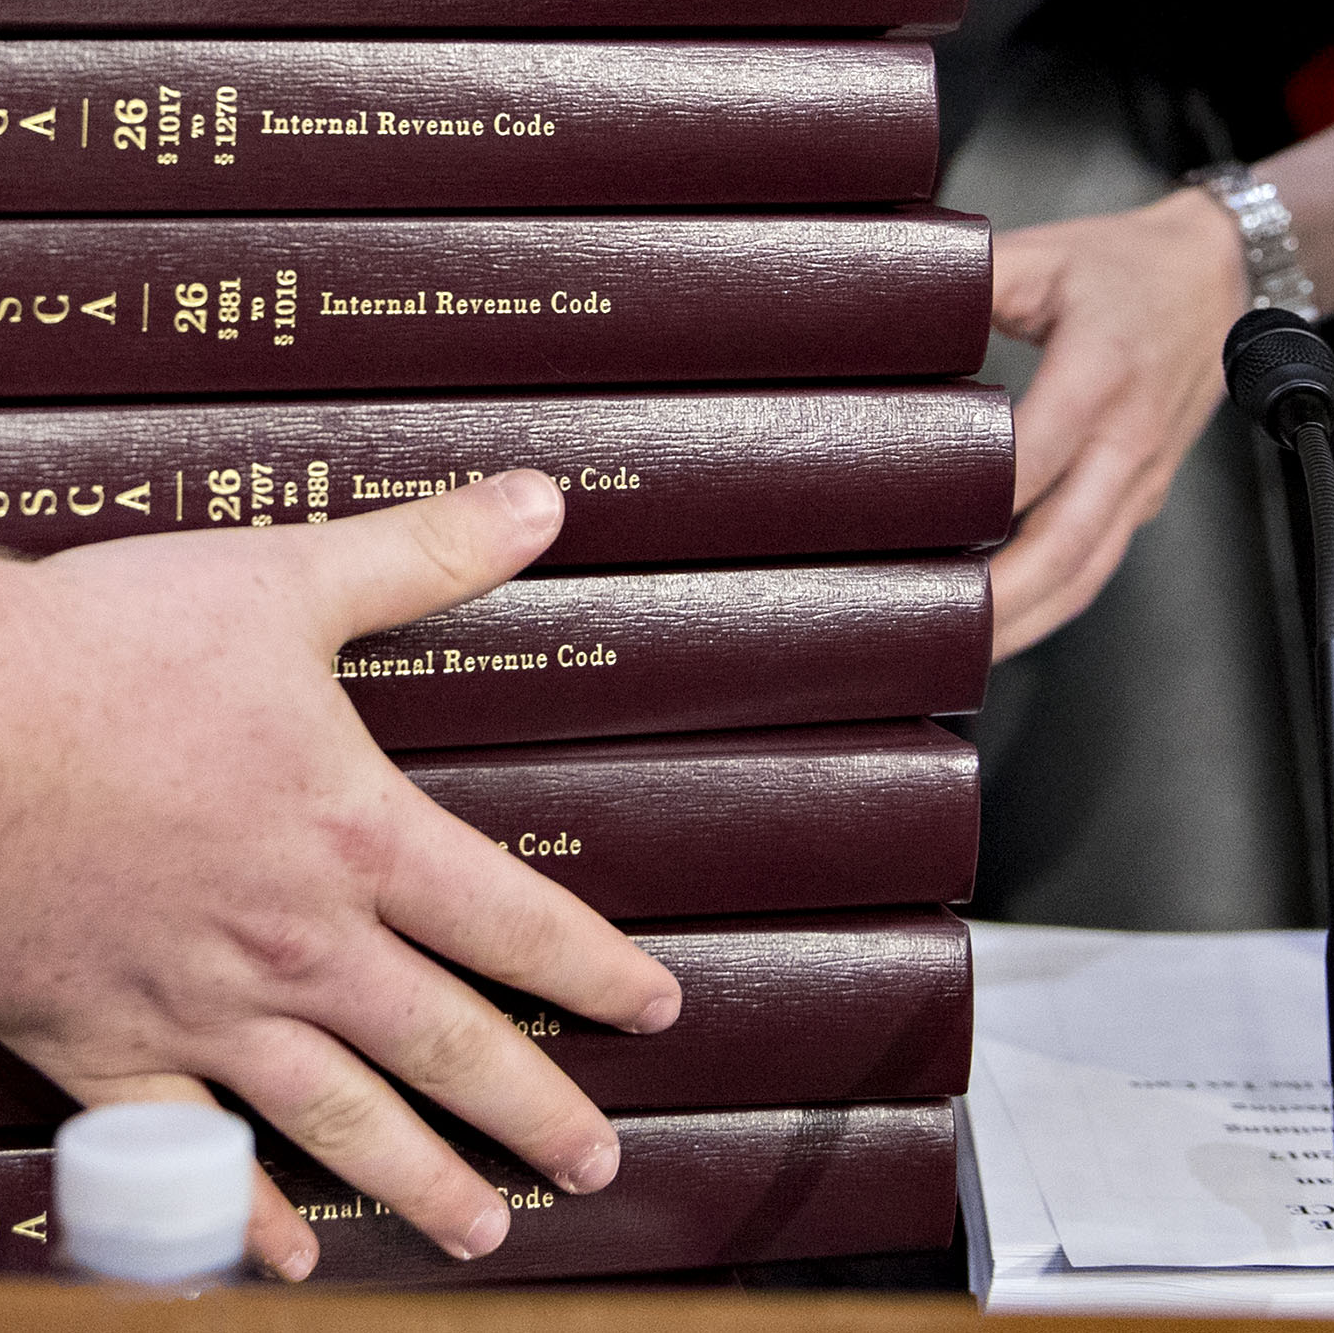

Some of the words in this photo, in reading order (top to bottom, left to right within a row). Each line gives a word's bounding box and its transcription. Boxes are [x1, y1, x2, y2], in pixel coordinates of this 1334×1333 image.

[112, 97, 149, 151] 26
[260, 109, 368, 135] Internal
[376, 110, 484, 137] Revenue
[493, 113, 555, 136] Code
[173, 281, 209, 334] 26
[319, 290, 427, 316] Internal
[434, 290, 542, 315] Revenue
[550, 290, 612, 314] Code
[207, 468, 242, 522] 26
[351, 470, 457, 500] Internal
[579, 466, 639, 490] Code
[331, 650, 435, 678] Internal
[442, 648, 548, 674] Revenue
[556, 642, 617, 668] Code
[518, 831, 582, 857] Code
[503, 1011, 561, 1037] ode
[297, 1195, 364, 1222] ernal
